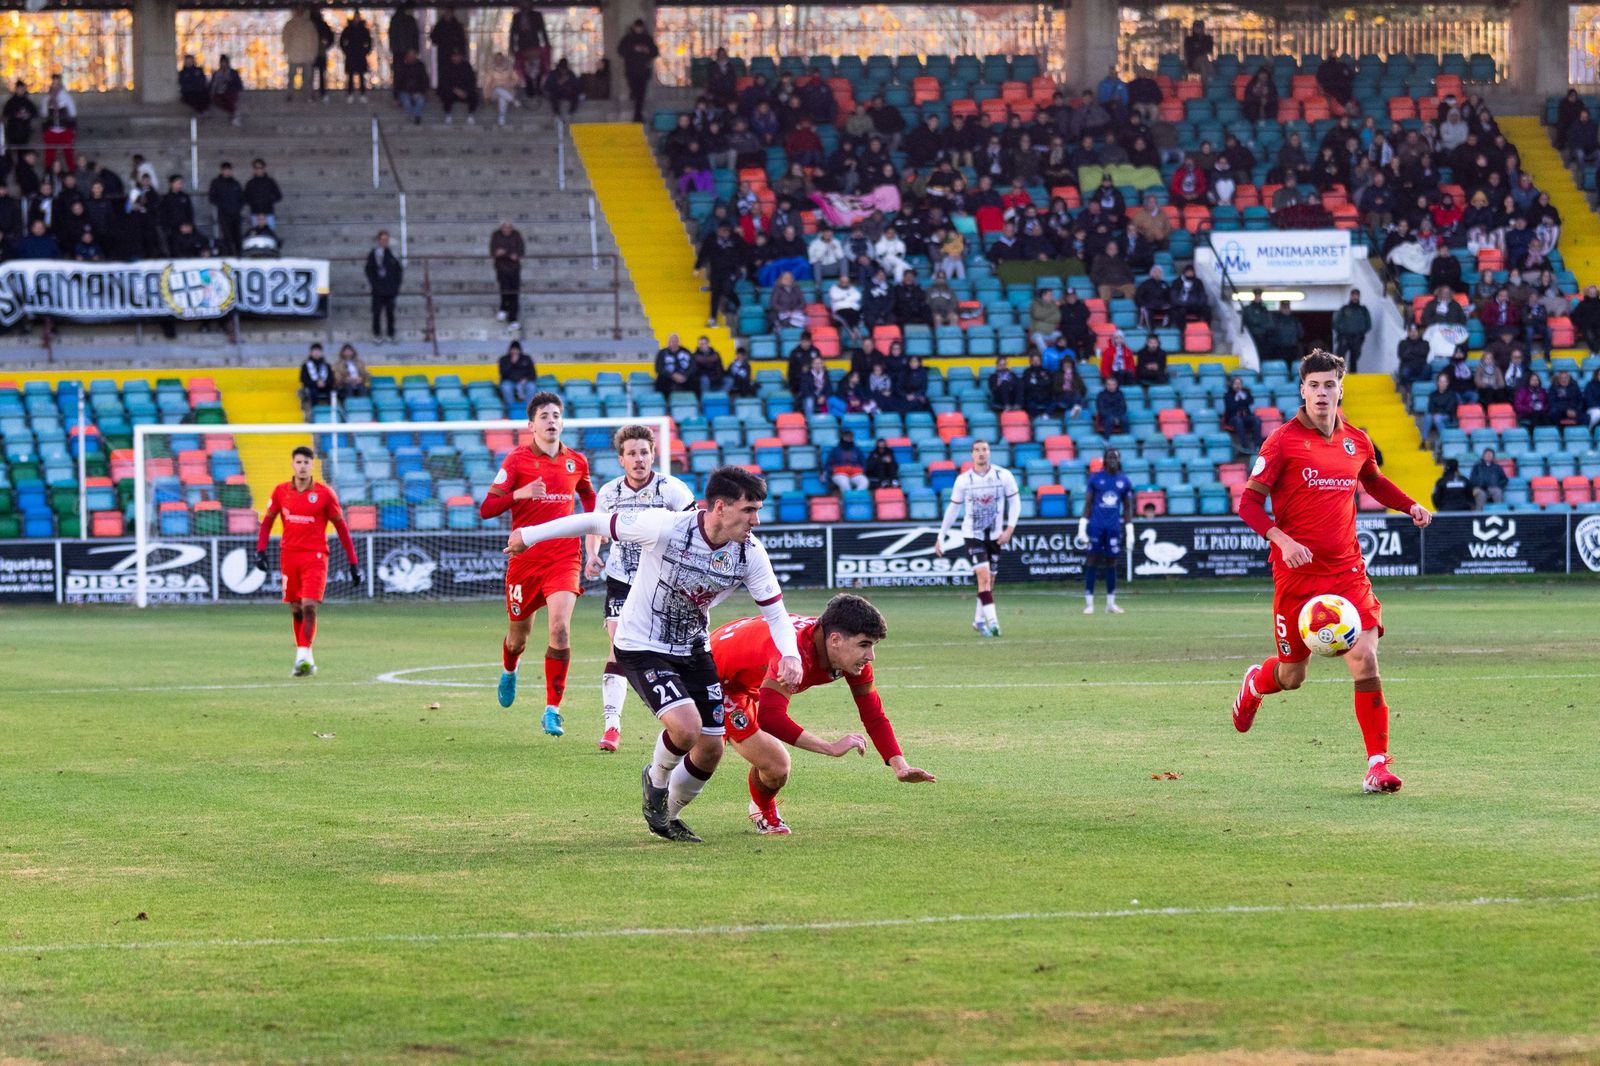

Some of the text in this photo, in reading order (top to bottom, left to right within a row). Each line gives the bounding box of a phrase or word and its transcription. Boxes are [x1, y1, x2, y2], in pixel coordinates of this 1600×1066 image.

[1256, 246, 1347, 258] MINIMARKET
[234, 270, 312, 308] 1923
[1356, 520, 1387, 529] GENERAL
[760, 532, 824, 549] torbikes
[1194, 535, 1270, 551] EL PATO ROJO
[1468, 542, 1517, 558] Wake
[836, 558, 973, 574] DISCOSA
[1030, 565, 1082, 575] SALAMANCA
[66, 574, 208, 590] DISCOSA
[836, 578, 853, 588] DE
[509, 584, 523, 603] 14
[1276, 614, 1287, 638] 5
[652, 680, 682, 705] 21
